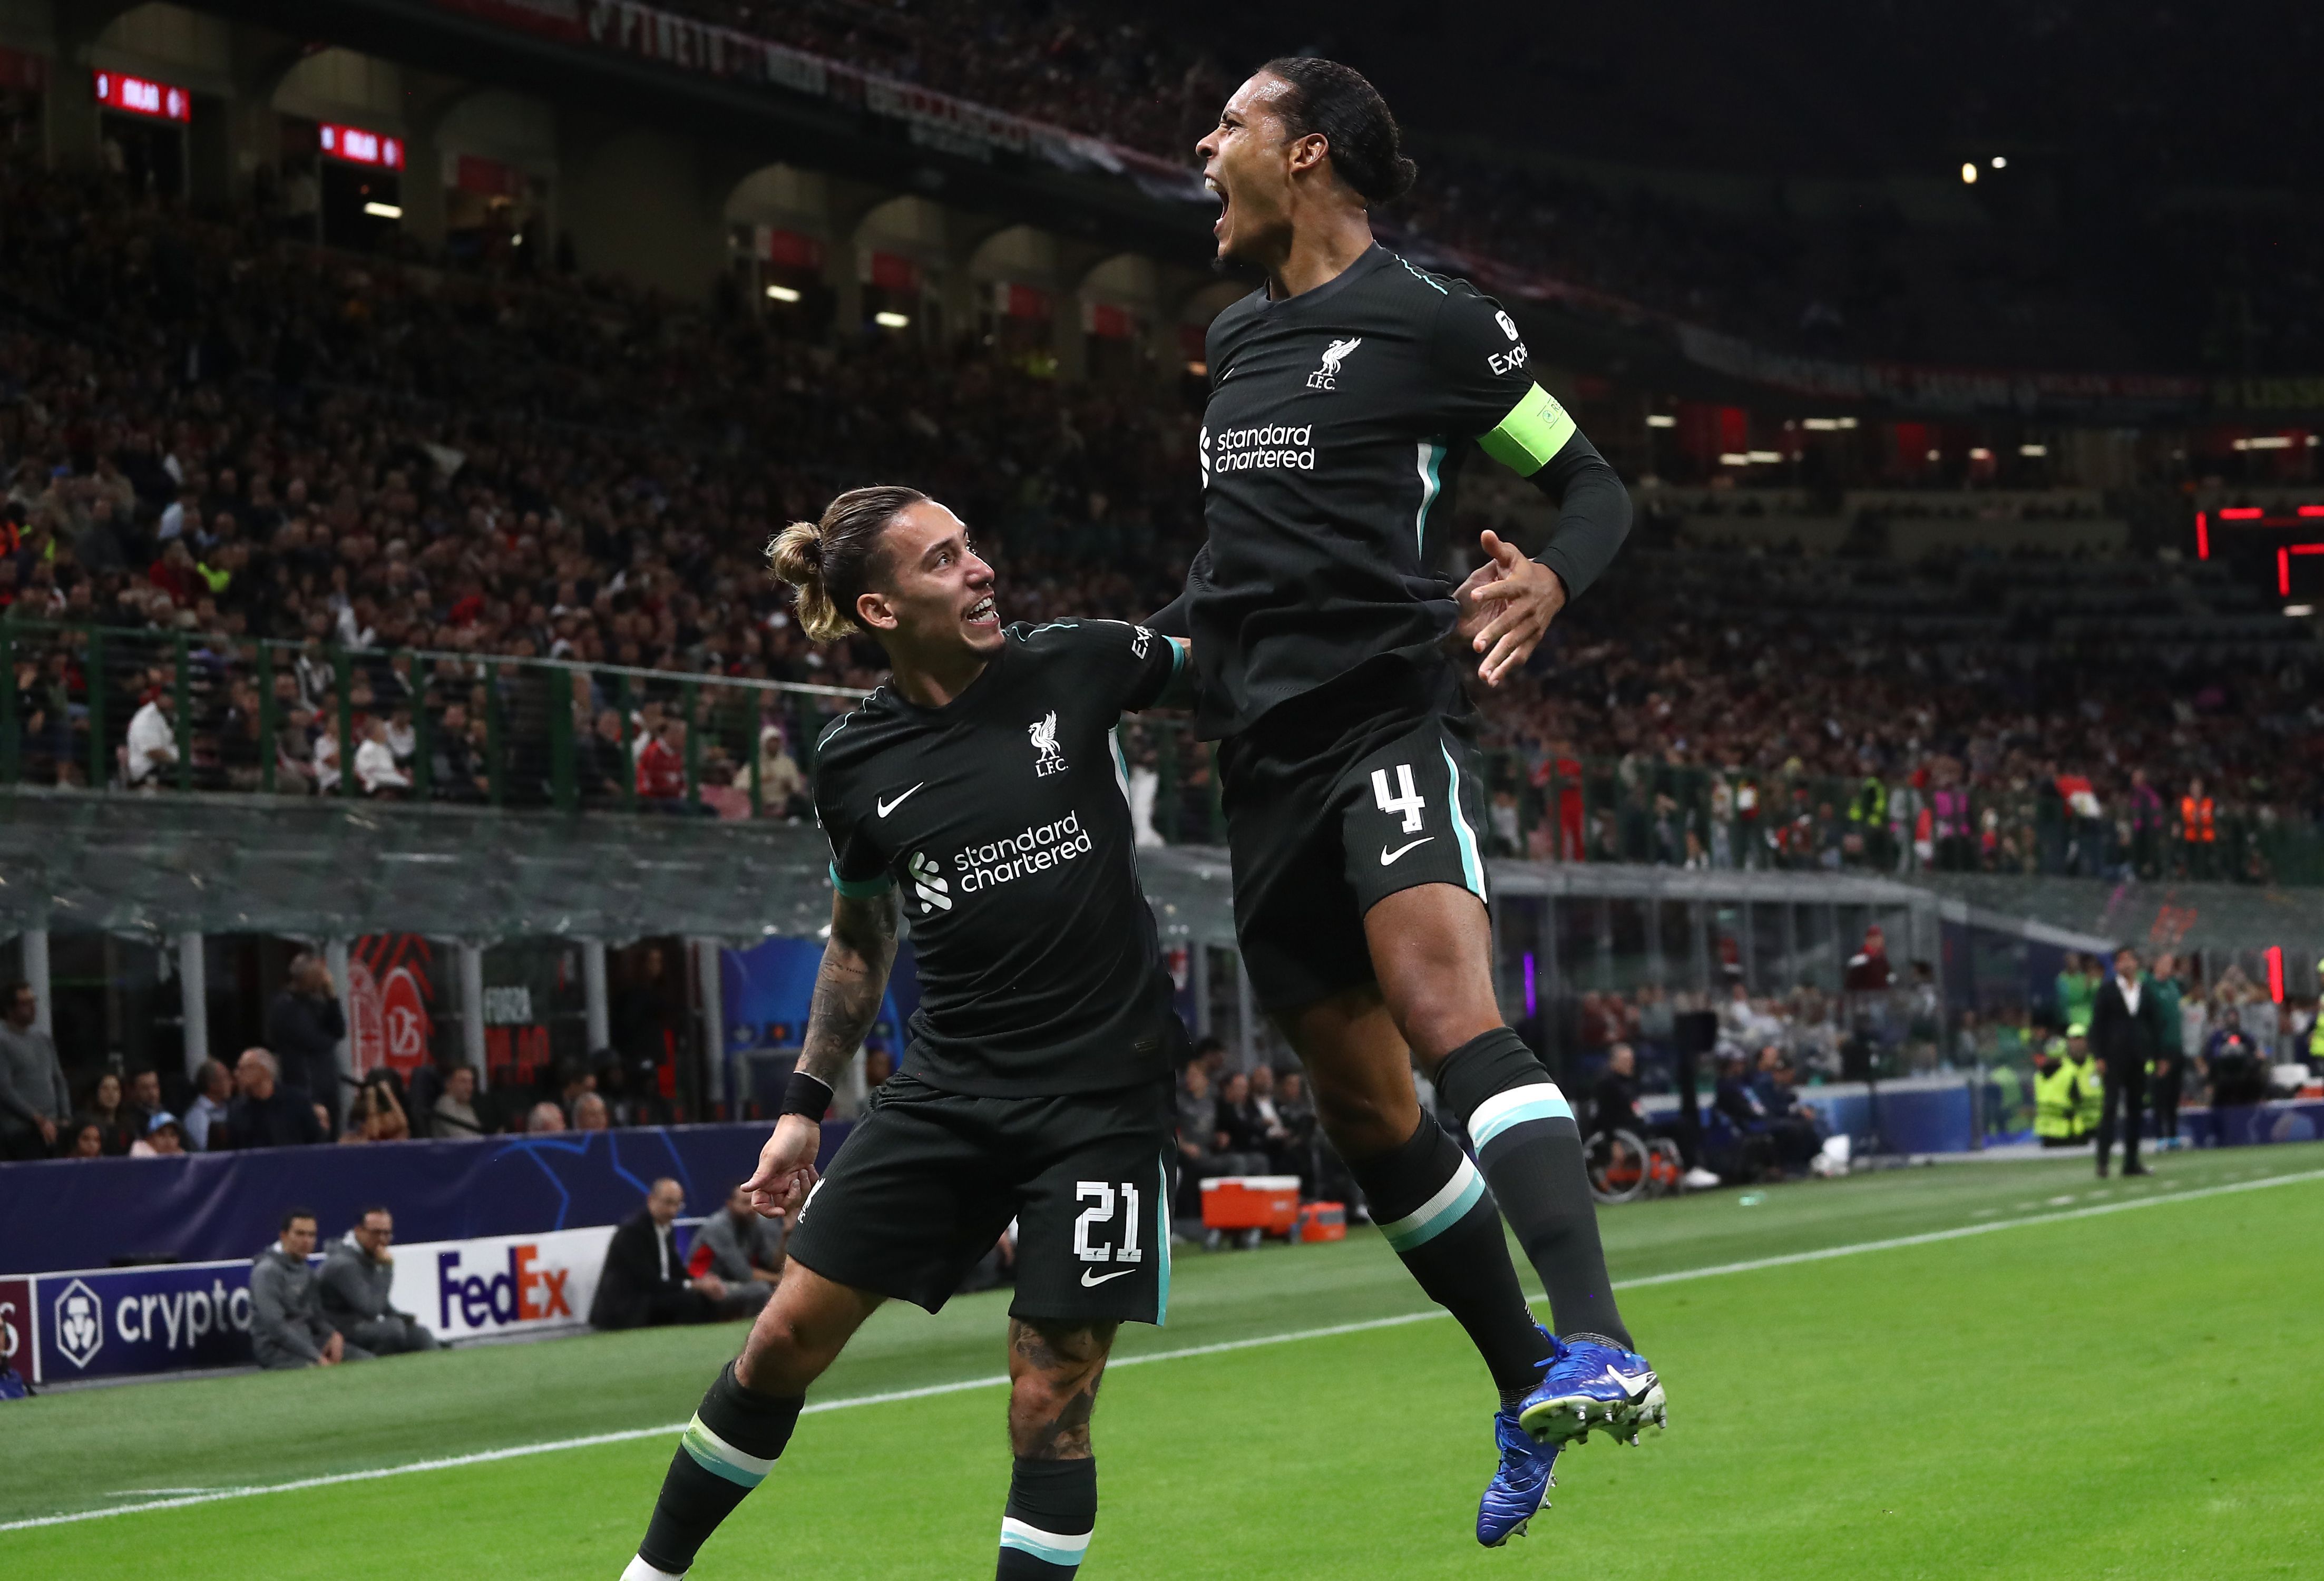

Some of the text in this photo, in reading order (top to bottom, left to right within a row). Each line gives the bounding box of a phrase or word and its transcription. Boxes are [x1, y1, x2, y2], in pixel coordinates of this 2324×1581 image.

[1215, 447, 1315, 473] chartered
[1217, 423, 1312, 451] standard
[1035, 758, 1069, 777] L.F.C.
[1371, 764, 1425, 835] 4
[954, 809, 1079, 872] standard
[961, 828, 1092, 893] chartered
[1073, 1181, 1142, 1263] 21
[116, 1278, 253, 1349] crypto
[441, 1244, 571, 1326] FedEx
